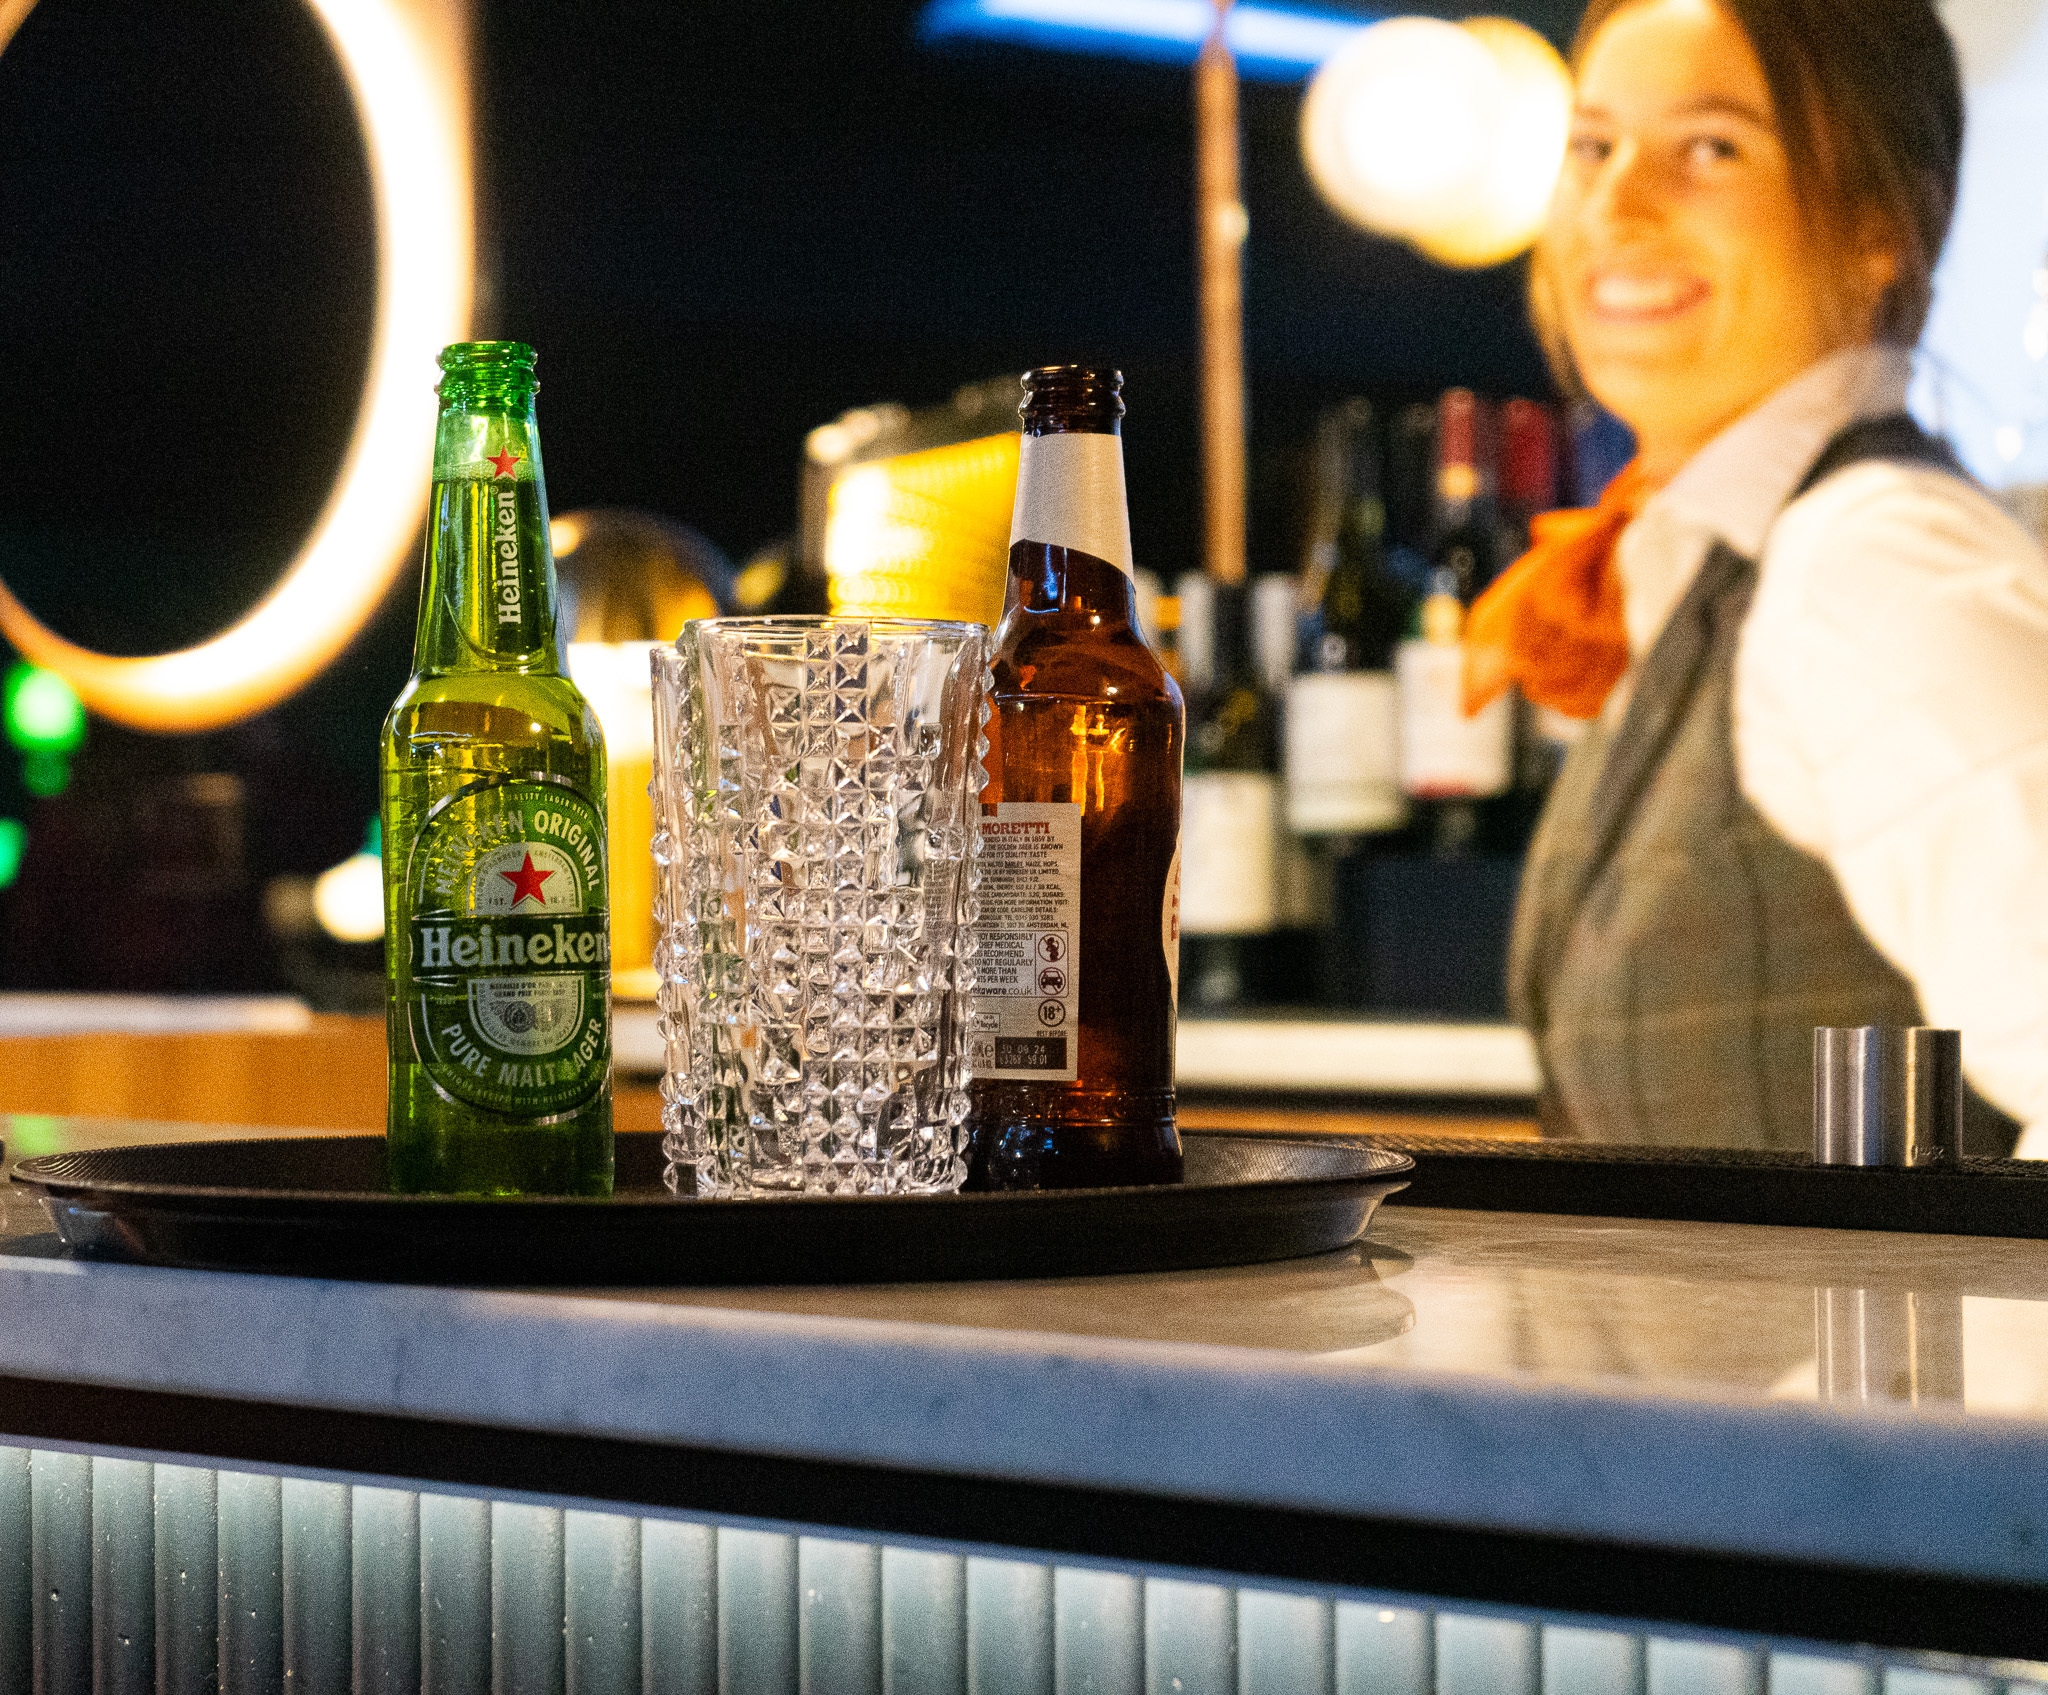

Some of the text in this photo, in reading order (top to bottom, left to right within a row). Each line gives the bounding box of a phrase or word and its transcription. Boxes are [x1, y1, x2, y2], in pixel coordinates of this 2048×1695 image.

[499, 490, 522, 624] Heineken
[981, 821, 1051, 835] MORETTI
[533, 809, 601, 893] ORIGINAL
[989, 933, 1034, 941] RESPONSIBLY
[420, 924, 611, 968] Heineken
[979, 941, 1025, 949] CHIEF MEDICAL
[983, 950, 1025, 958] RECOMMEND
[981, 967, 997, 975] MORE
[997, 967, 1017, 975] THAN
[987, 975, 998, 983] PER
[998, 975, 1019, 983] WEEK
[1042, 1005, 1062, 1020] 18+
[441, 1023, 492, 1078] PURE
[565, 1018, 602, 1074] AGER
[498, 1062, 558, 1088] MALT
